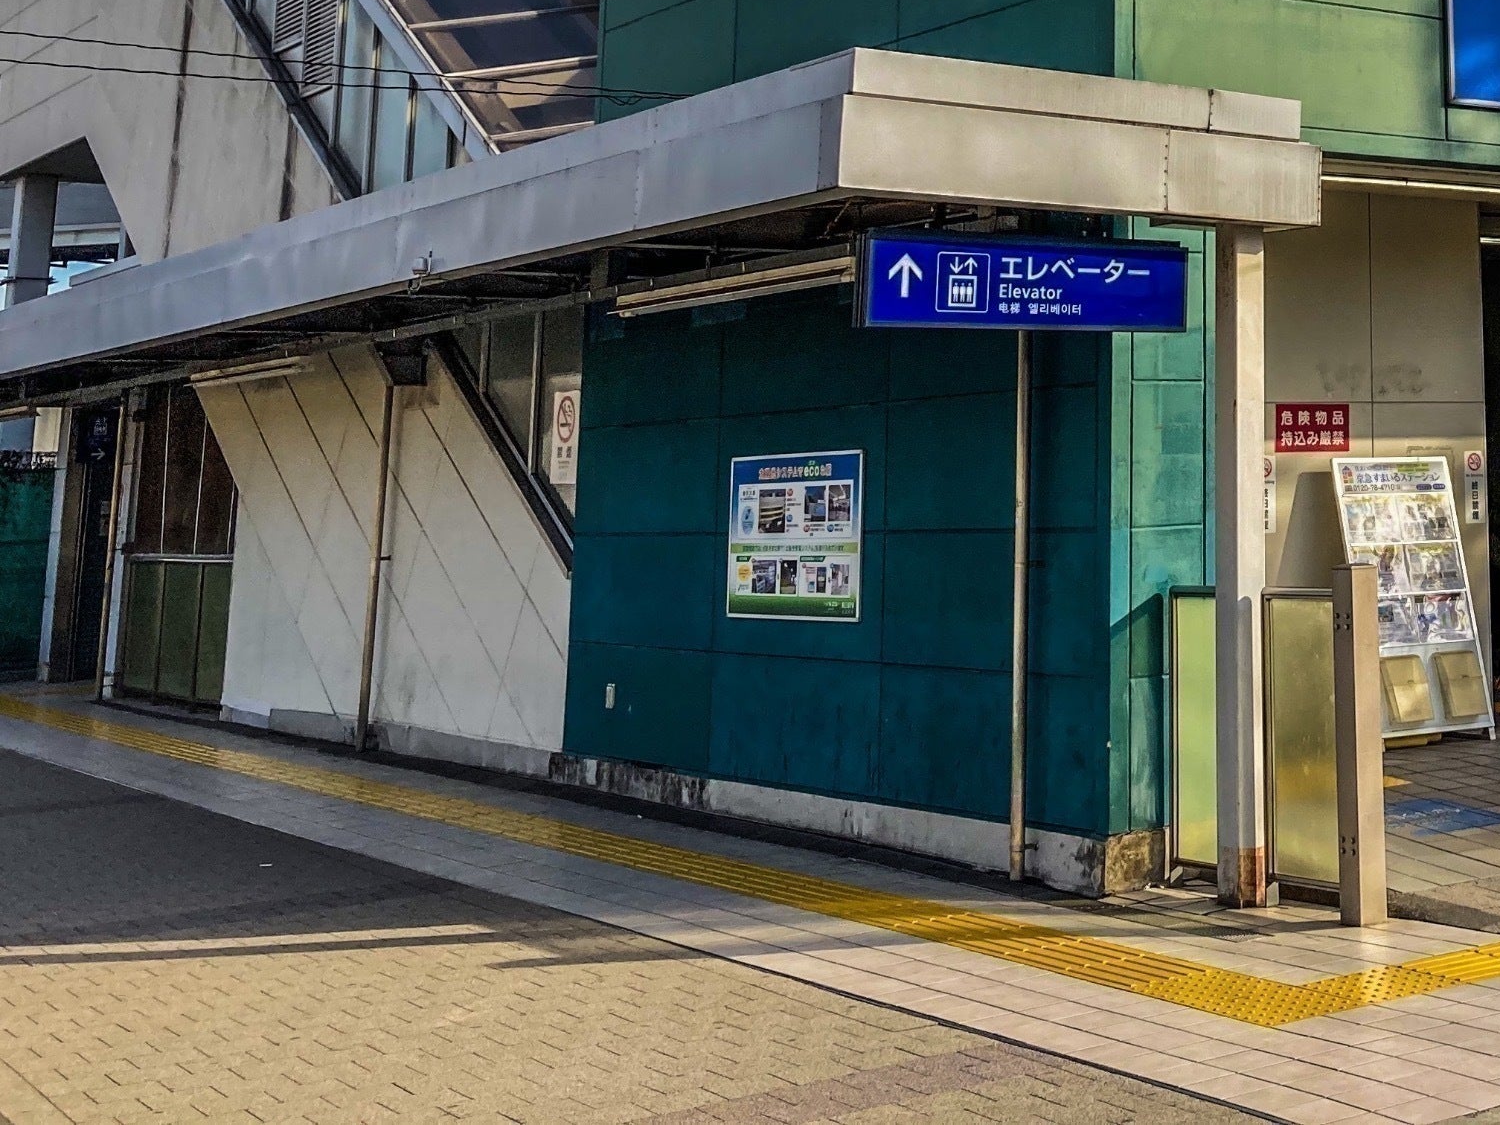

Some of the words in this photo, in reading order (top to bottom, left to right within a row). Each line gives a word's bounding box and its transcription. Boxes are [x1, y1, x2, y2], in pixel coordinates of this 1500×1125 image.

[999, 256, 1150, 284] エレベーター
[998, 283, 1063, 300] Elevator
[1027, 302, 1082, 316] 엘리베이터
[1280, 410, 1345, 426] 危険物品
[1281, 430, 1345, 446] 持込み厳禁
